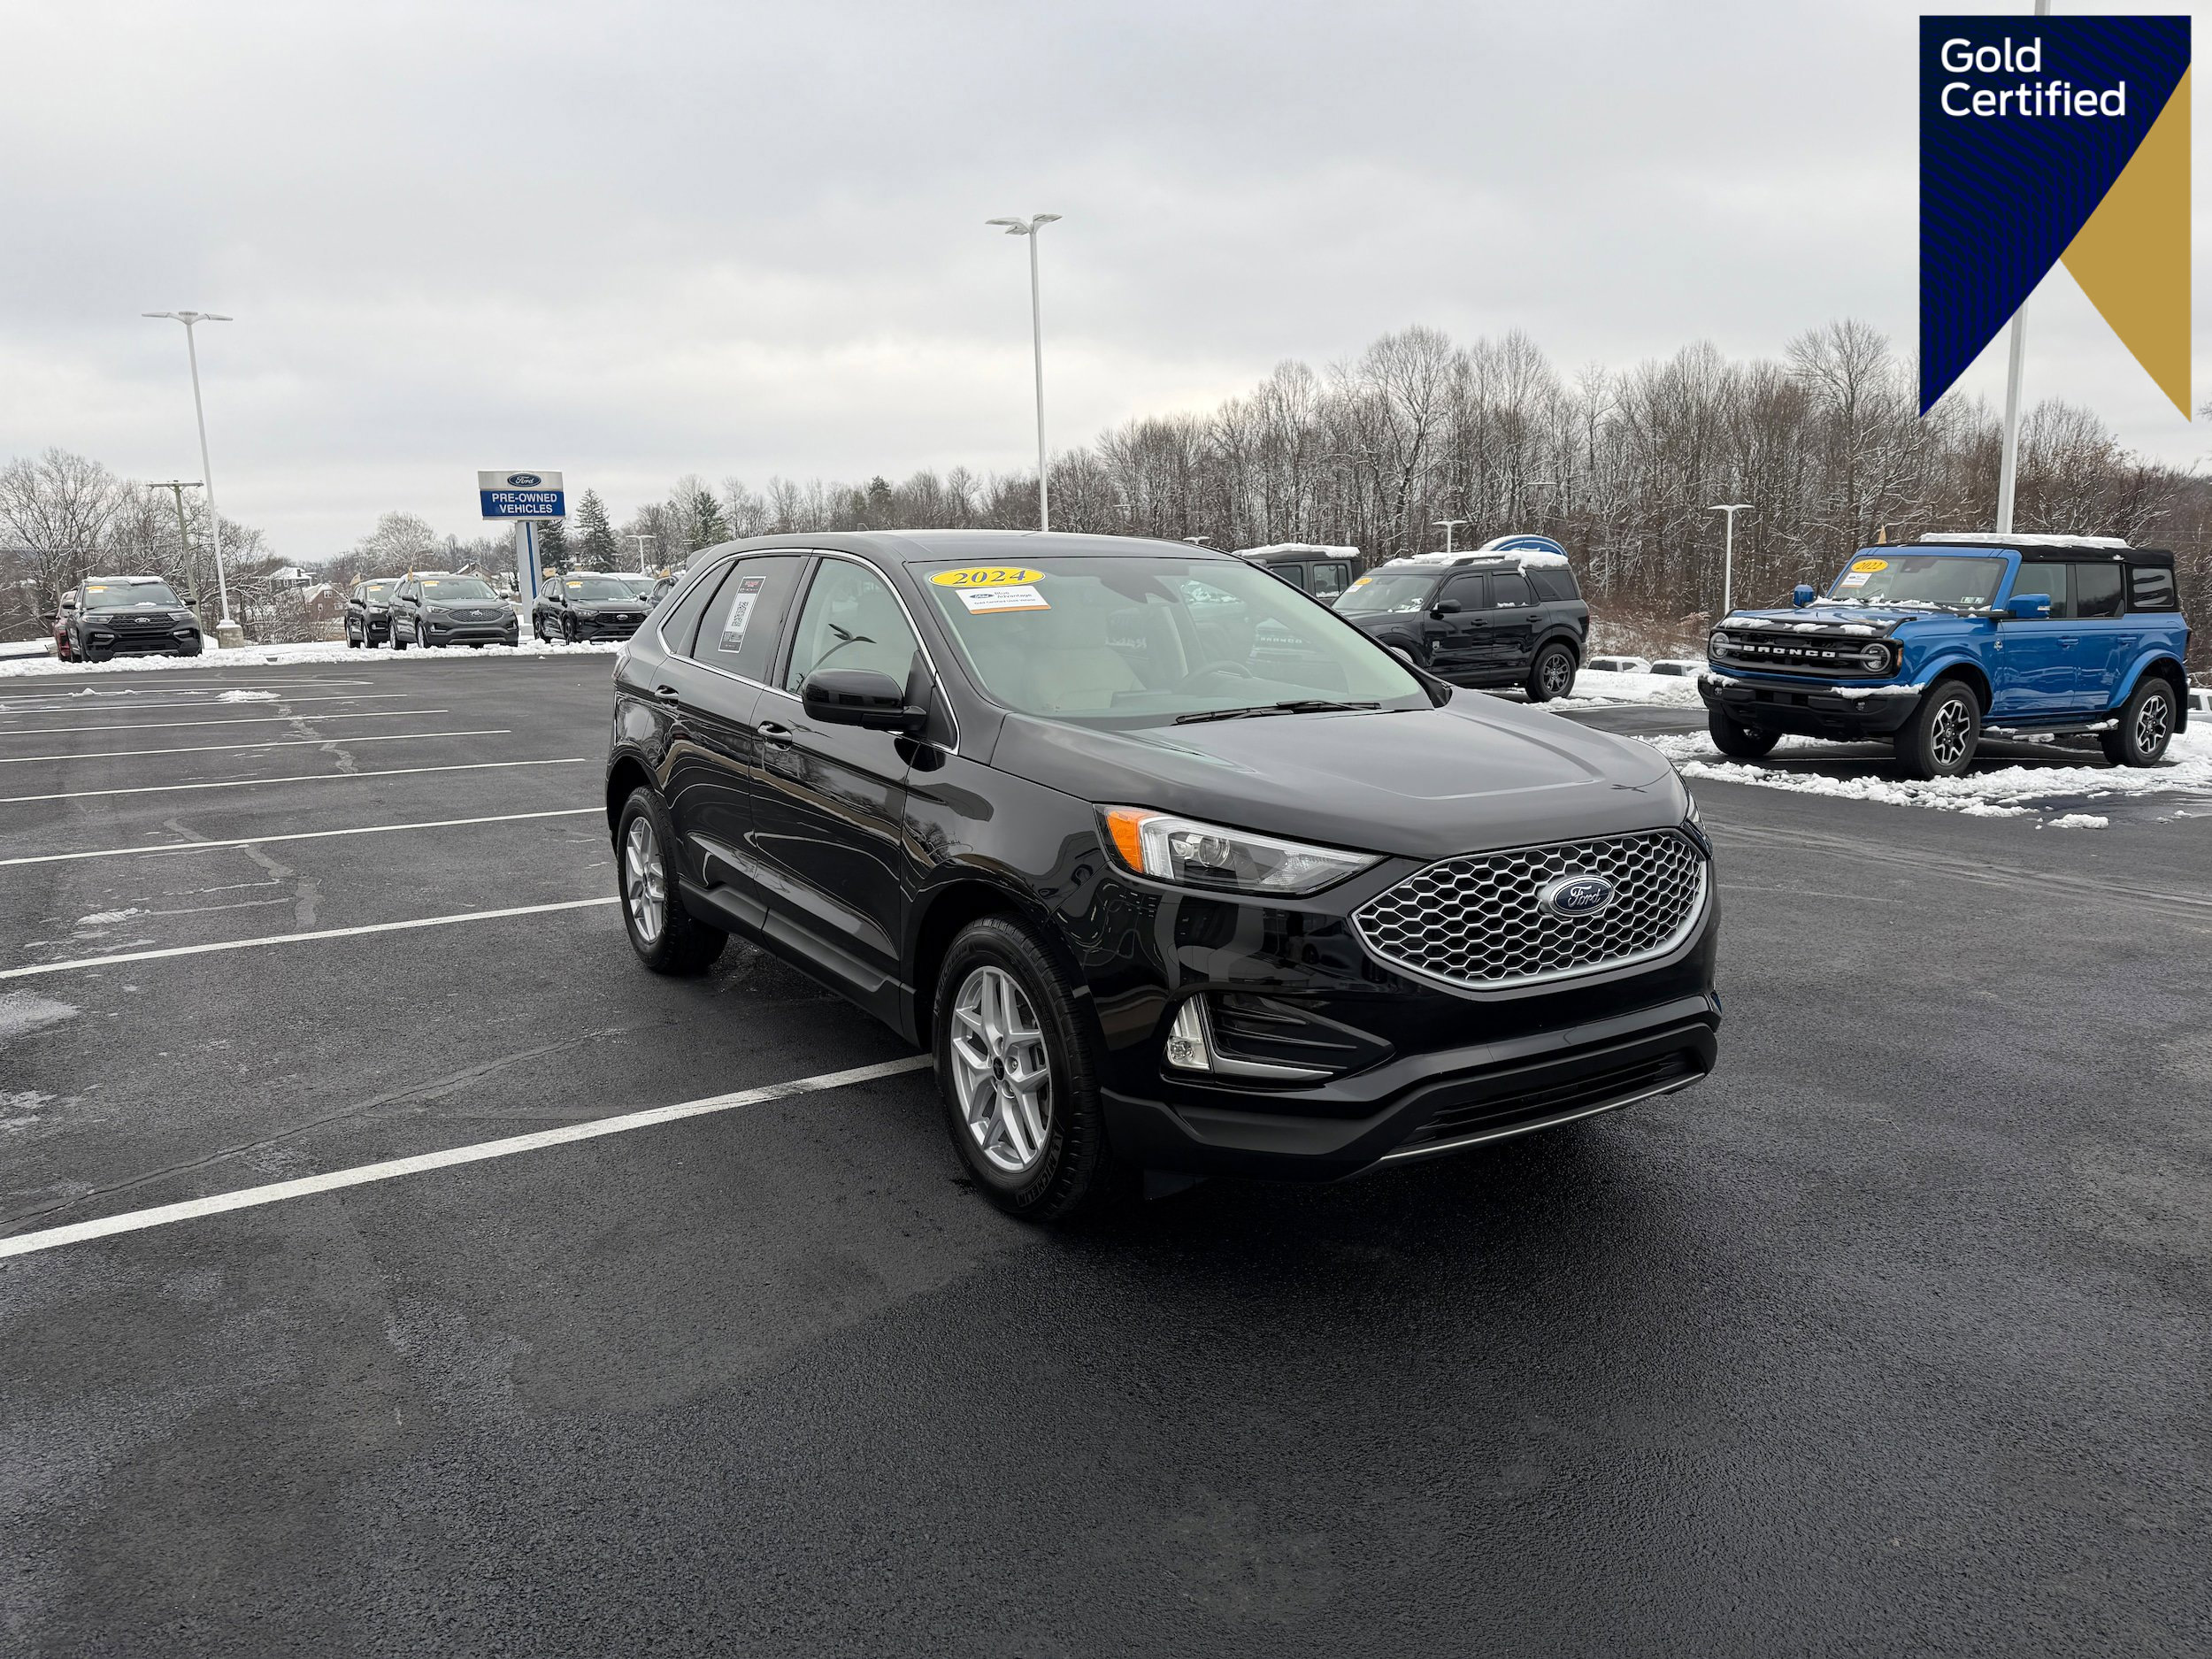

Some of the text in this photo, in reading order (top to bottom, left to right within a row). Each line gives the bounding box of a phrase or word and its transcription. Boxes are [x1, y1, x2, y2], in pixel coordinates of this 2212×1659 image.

[491, 493, 557, 503] PRE-OWNED
[499, 503, 553, 513] VEHICLES
[953, 570, 1025, 584] 2024
[1743, 645, 1836, 657] BRONCO
[1567, 886, 1601, 908] Ford
